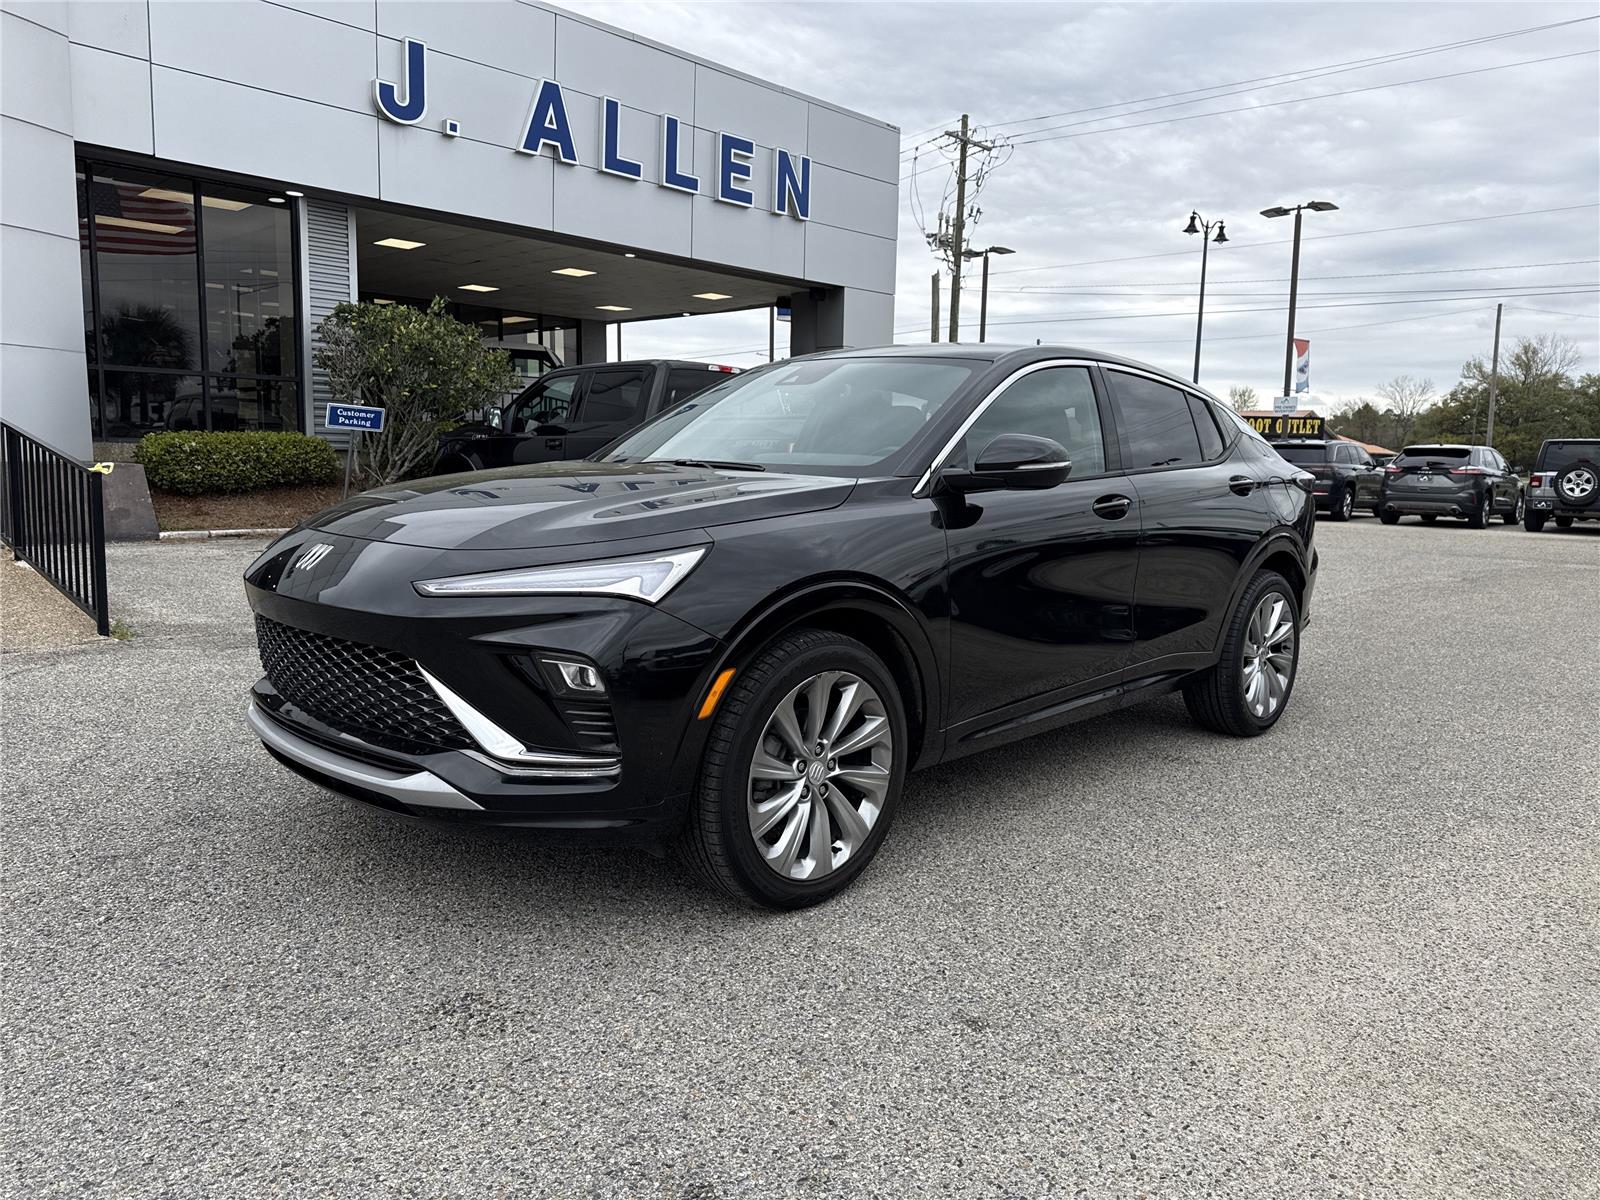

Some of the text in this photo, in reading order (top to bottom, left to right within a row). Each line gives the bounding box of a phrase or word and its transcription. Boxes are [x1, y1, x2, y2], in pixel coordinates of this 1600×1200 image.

[372, 37, 813, 221] J. ALLEN
[337, 409, 375, 418] Customer
[339, 417, 371, 427] Parking
[1247, 418, 1271, 433] OOT
